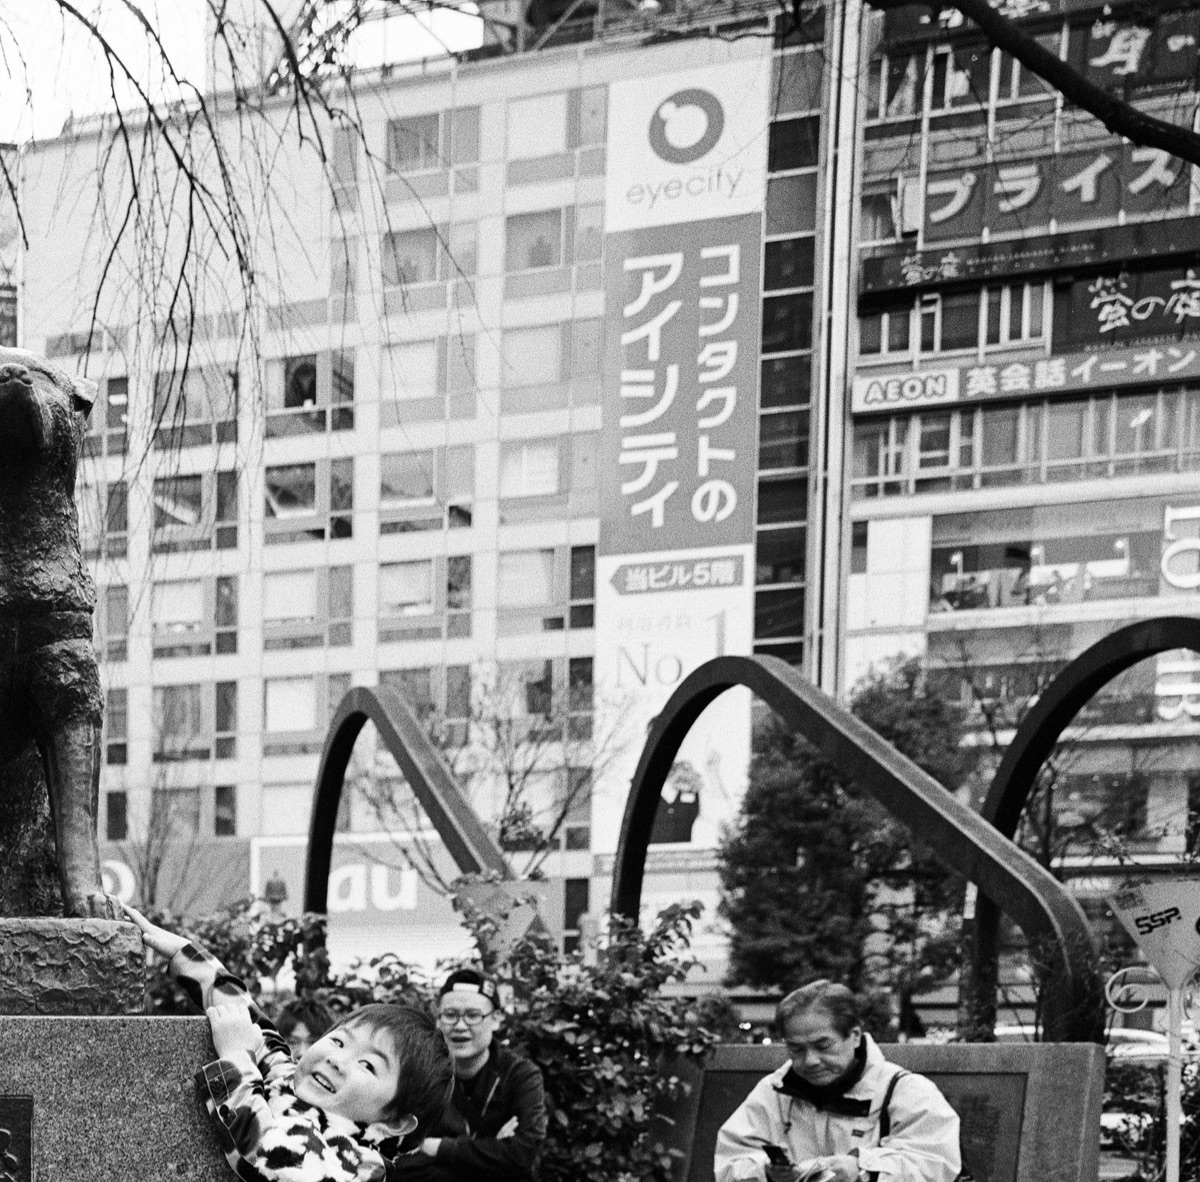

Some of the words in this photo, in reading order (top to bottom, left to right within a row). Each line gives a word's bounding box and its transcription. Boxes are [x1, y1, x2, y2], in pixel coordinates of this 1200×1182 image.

[625, 166, 744, 210] eyecity
[618, 251, 685, 528] アイシティ
[690, 243, 741, 524] コンタクトの
[863, 373, 948, 404] AEON
[965, 350, 1196, 397] 英会話イーオン
[327, 862, 417, 912] au
